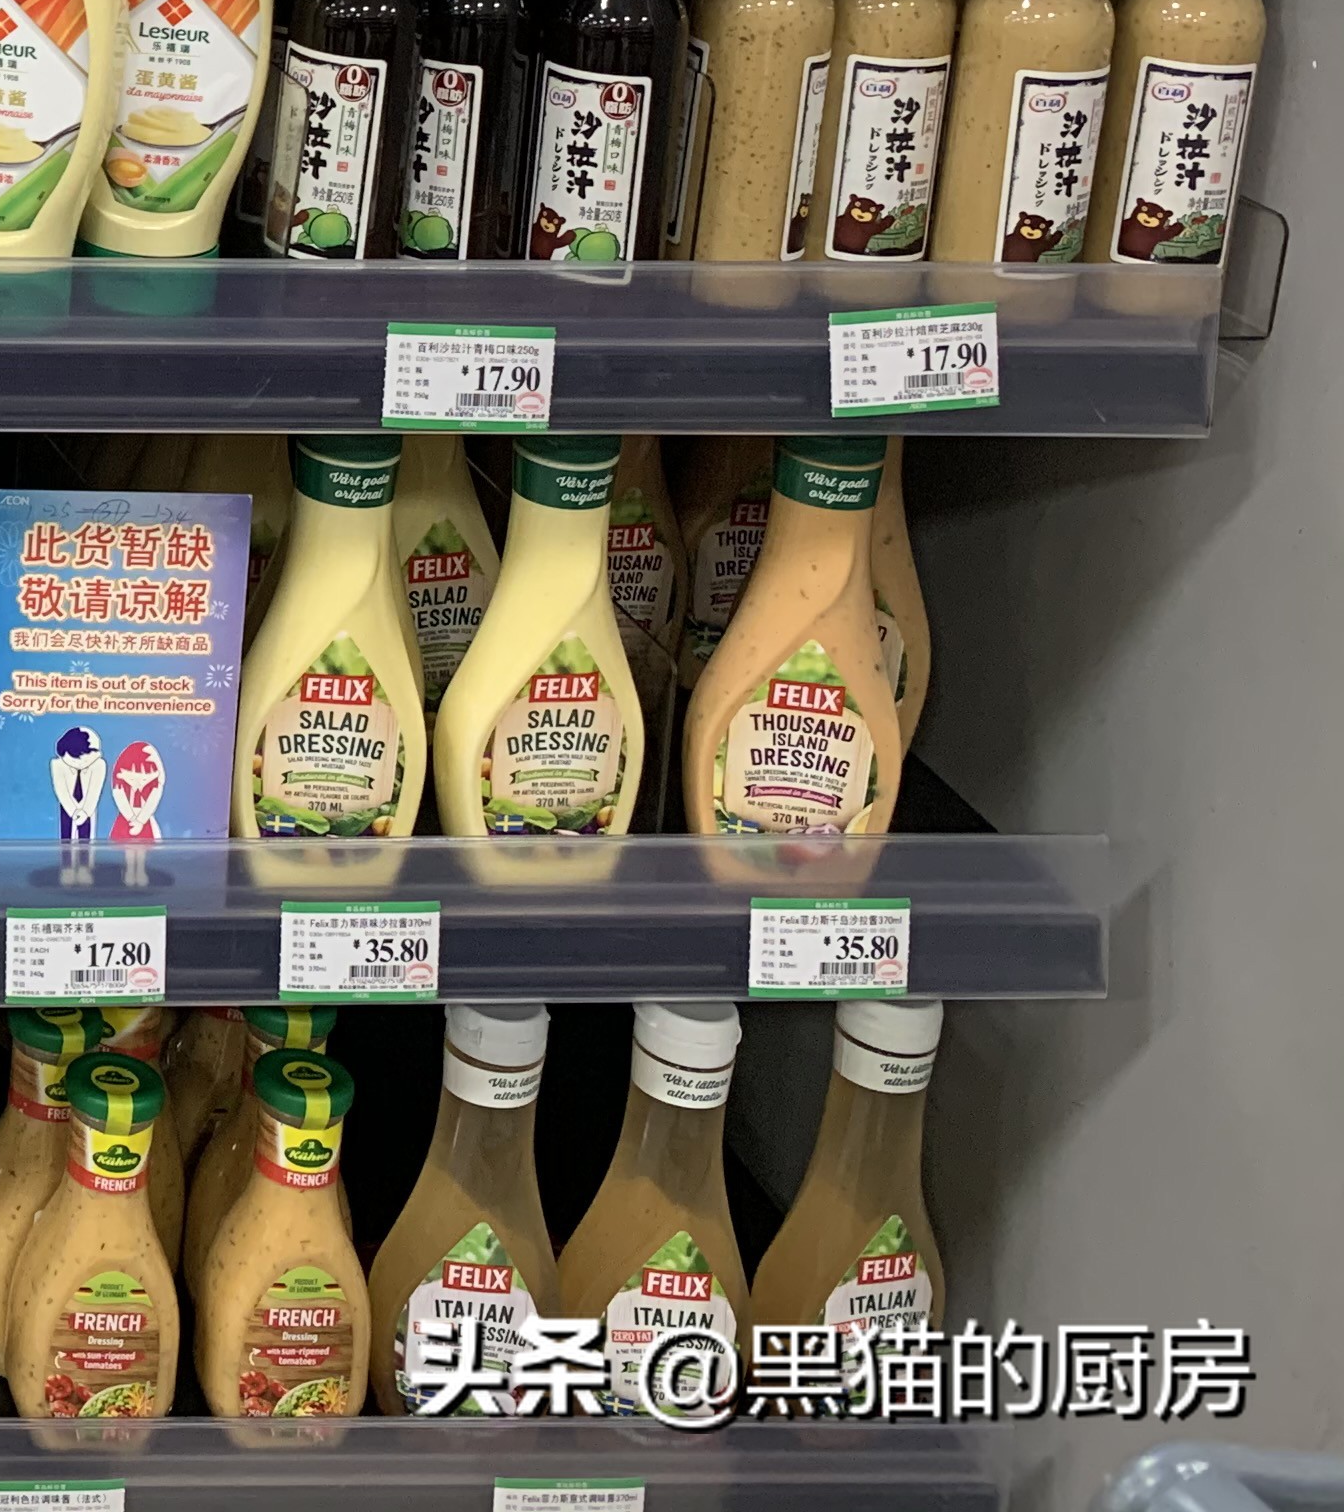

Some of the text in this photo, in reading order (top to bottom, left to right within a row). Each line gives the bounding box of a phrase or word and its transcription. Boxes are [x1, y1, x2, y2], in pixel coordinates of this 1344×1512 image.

[566, 110, 602, 200] 沙拉汁
[606, 125, 624, 176] 青梅口味
[861, 321, 984, 341] 百利沙拉汁焙煎芝麻230g
[417, 342, 540, 356] 百利沙拉汁青梅口味250g
[920, 343, 988, 371] 17.90
[475, 367, 541, 392] 17.90
[23, 524, 212, 569] 此货暂缺
[18, 576, 209, 623] 敬请谅解
[13, 630, 209, 652] 我们会尽快补齐所缺商品
[305, 677, 370, 701] FELIX
[299, 711, 369, 734] SALAD
[278, 734, 385, 760] DRESSING
[31, 922, 95, 935] 乐禧瑞芥末酱
[87, 942, 152, 968] 17.80
[365, 938, 429, 965] 35.80
[836, 935, 899, 959] 35.80
[646, 1273, 709, 1299] FELIX
[73, 1310, 143, 1333] FRENCH
[633, 1306, 714, 1330] ITALIAN
[87, 1335, 124, 1349] Dressing
